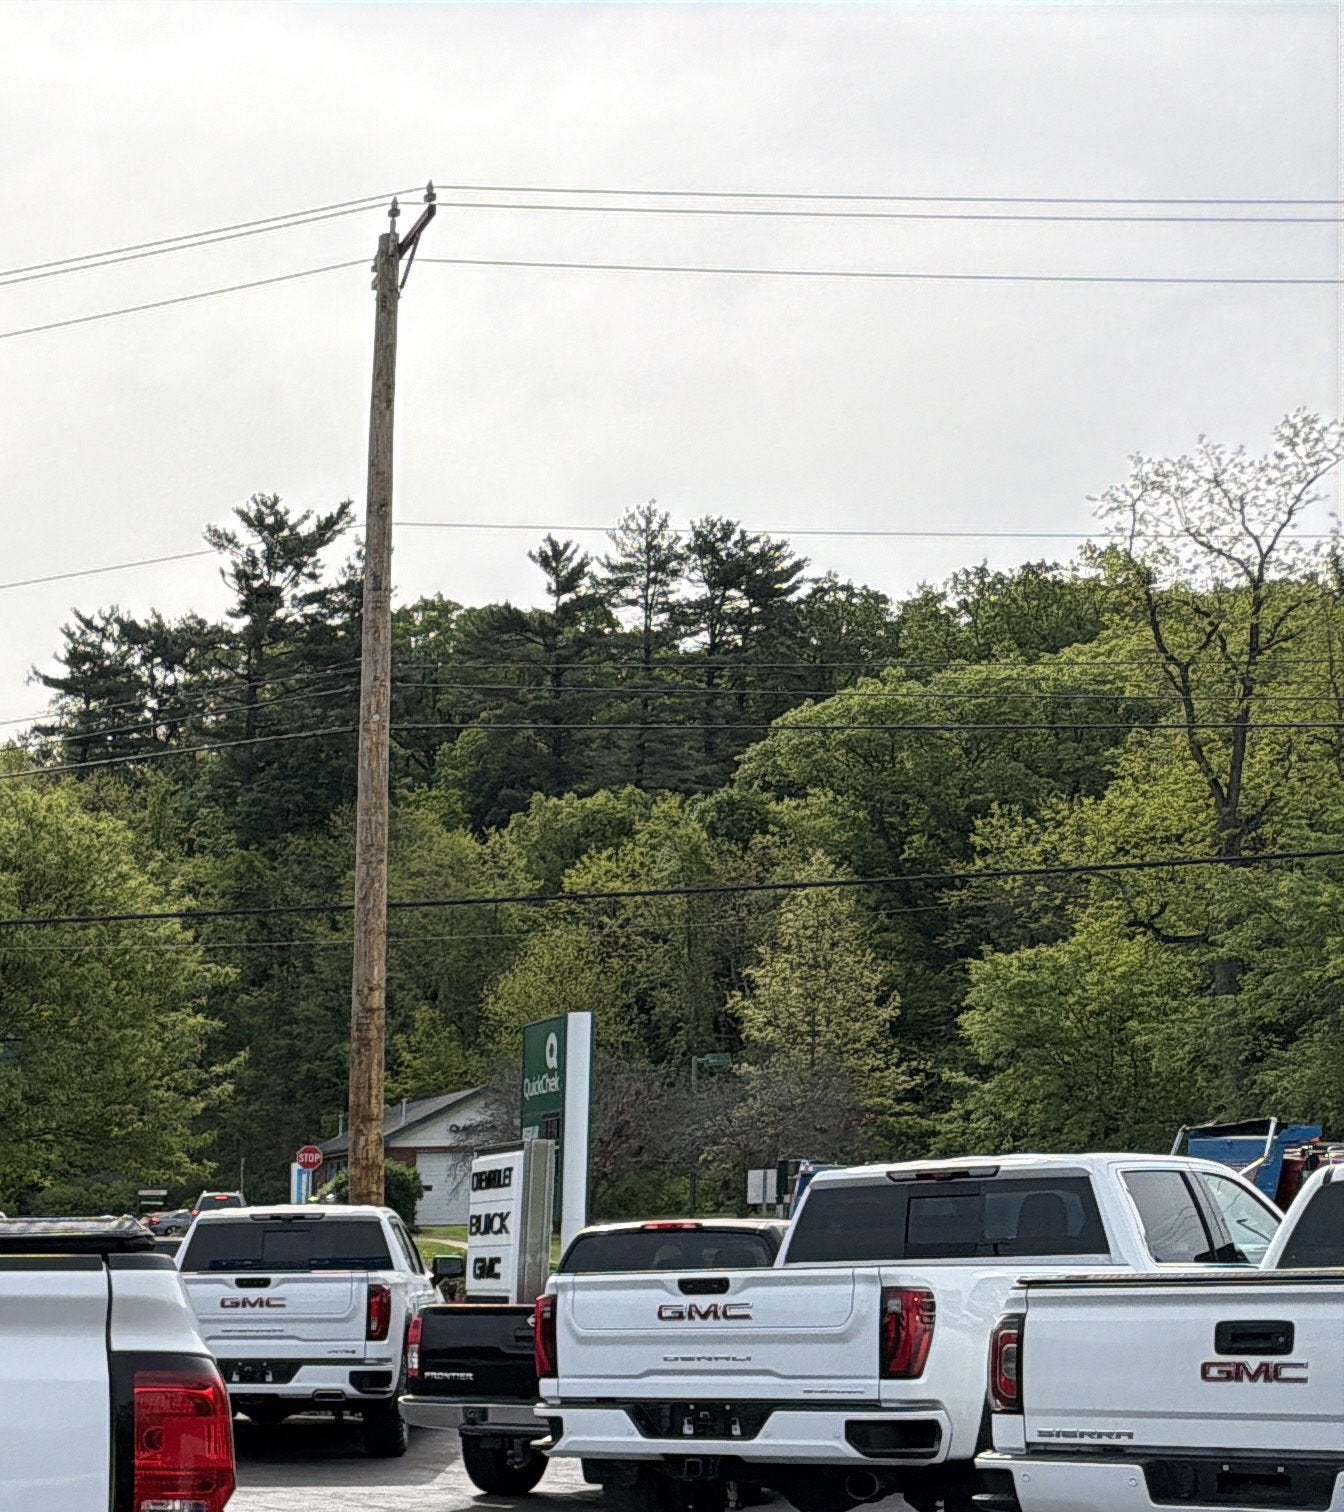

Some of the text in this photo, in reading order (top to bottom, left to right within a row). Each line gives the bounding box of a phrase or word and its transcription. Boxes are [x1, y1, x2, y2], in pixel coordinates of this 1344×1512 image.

[298, 1153, 321, 1163] STOP
[469, 1211, 512, 1236] BUICK
[473, 1256, 502, 1281] GMC
[219, 1296, 288, 1309] GMC
[657, 1302, 754, 1321] GMC
[663, 1354, 752, 1362] DENALI
[423, 1371, 474, 1381] FRONTIER
[1200, 1361, 1309, 1383] GMC
[1037, 1428, 1134, 1440] SIERRA
